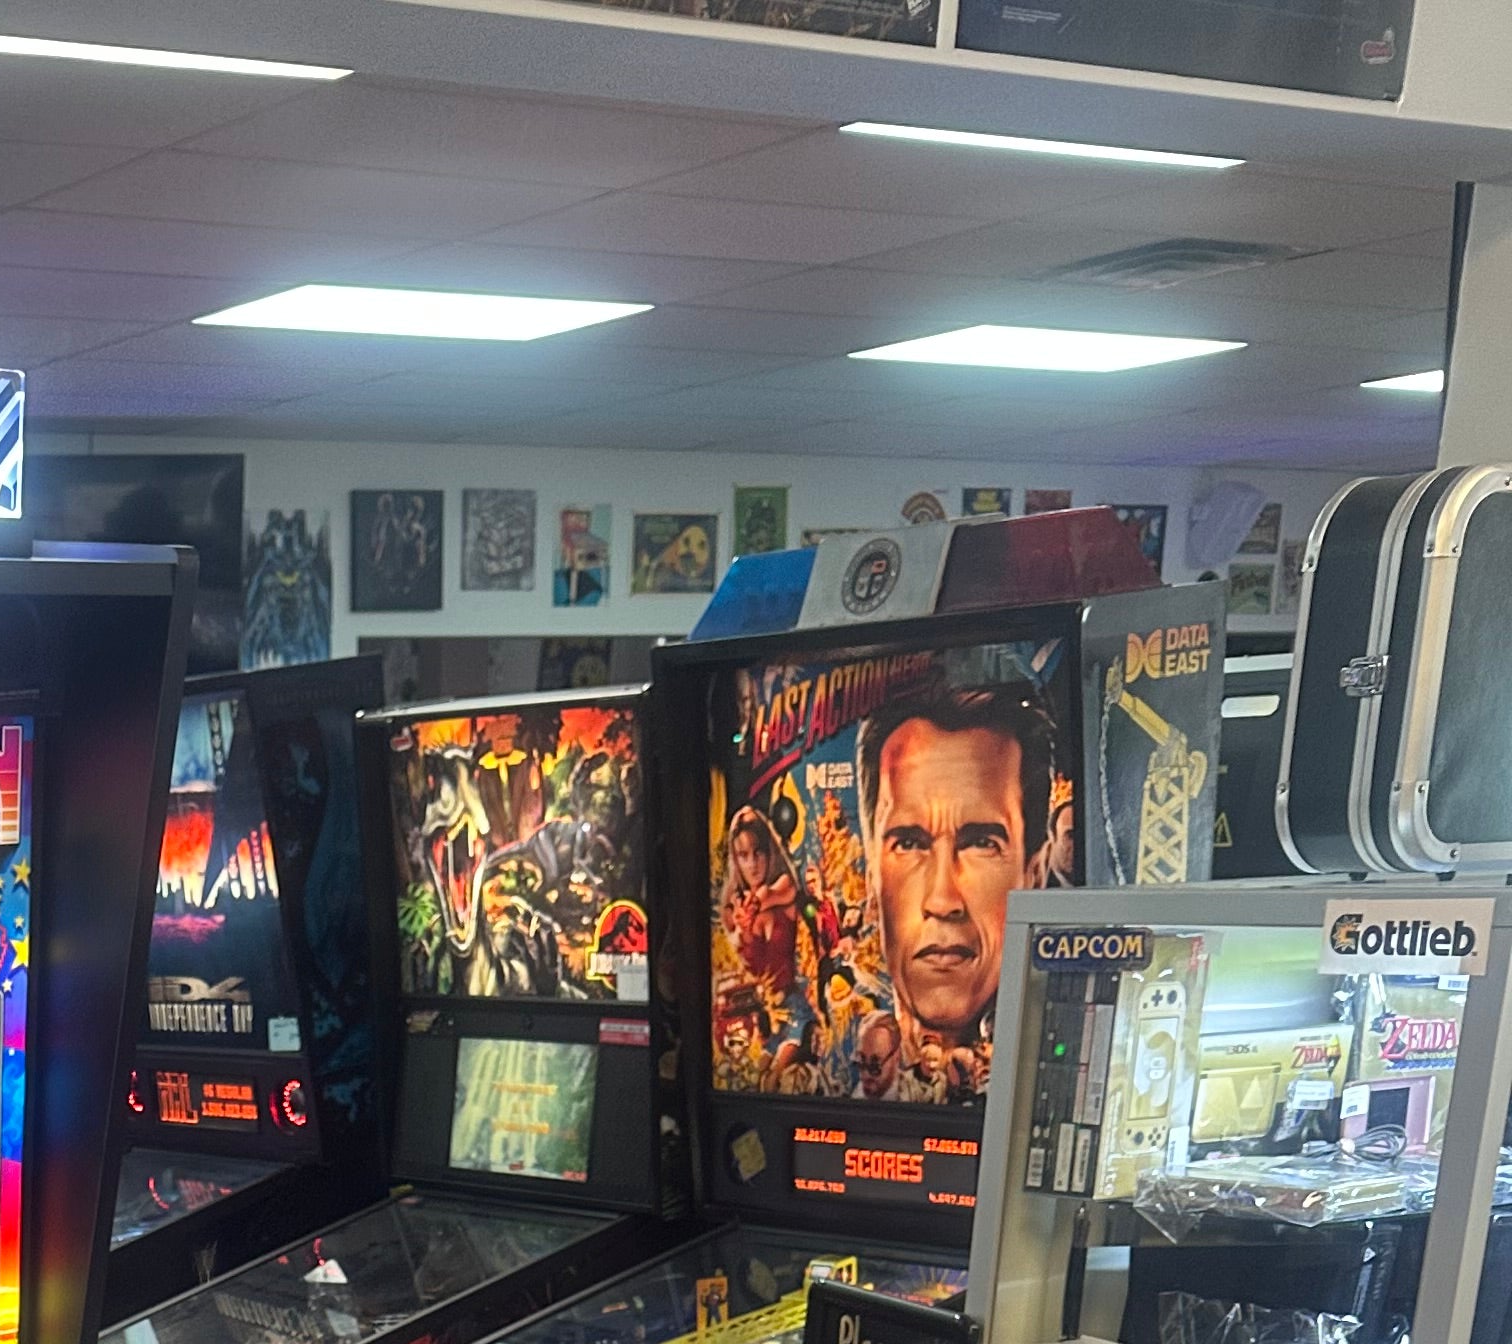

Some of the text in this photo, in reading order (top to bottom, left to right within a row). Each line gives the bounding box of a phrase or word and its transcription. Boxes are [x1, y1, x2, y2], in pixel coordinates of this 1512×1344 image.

[1165, 624, 1209, 650] DATA
[1165, 648, 1211, 676] EAST
[753, 658, 888, 769] LAST ACTION
[1036, 931, 1145, 961] CAPCOM
[844, 1148, 925, 1184] SCORES
